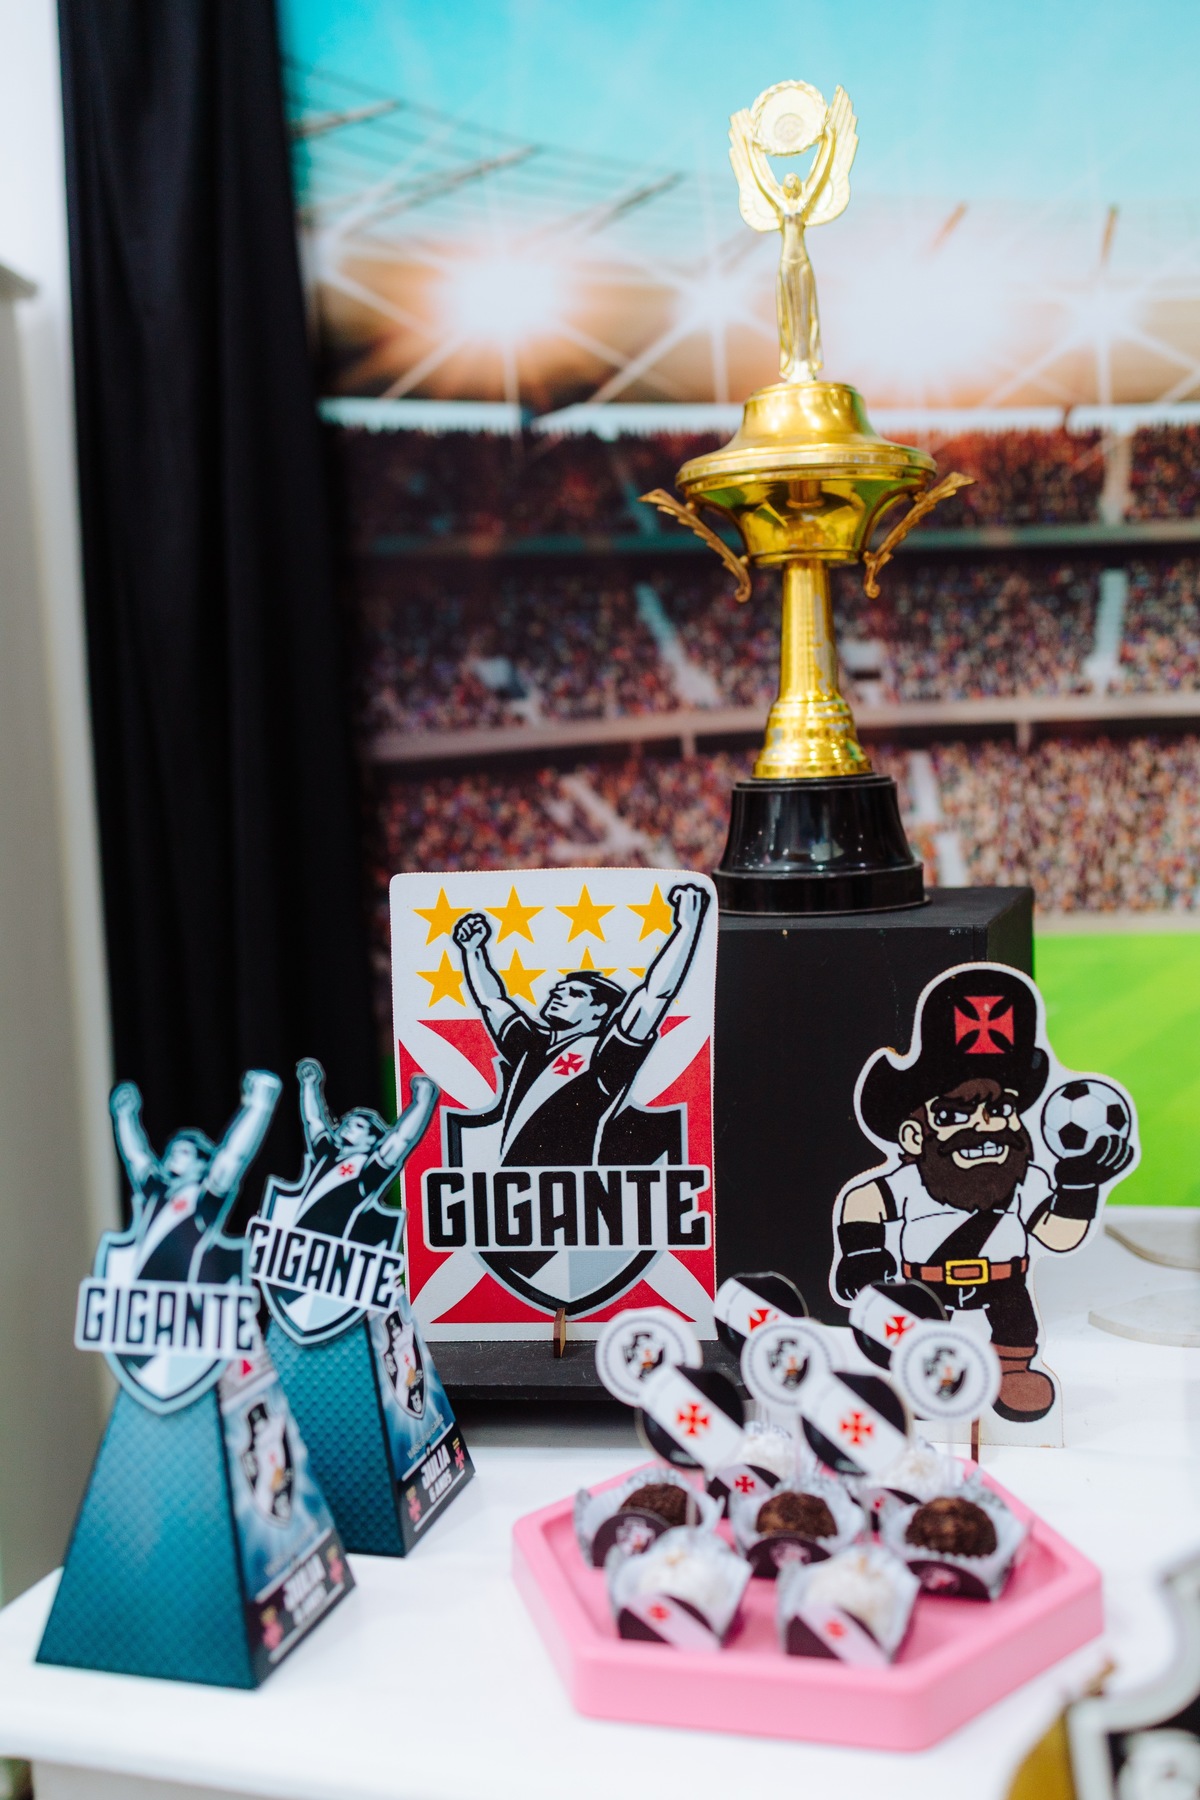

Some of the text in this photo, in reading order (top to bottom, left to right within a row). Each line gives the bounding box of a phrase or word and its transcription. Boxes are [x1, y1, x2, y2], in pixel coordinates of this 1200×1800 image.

[426, 1170, 706, 1248] GIGANTE
[251, 1222, 401, 1309] GIGANTE
[82, 1287, 253, 1351] GIGANTE
